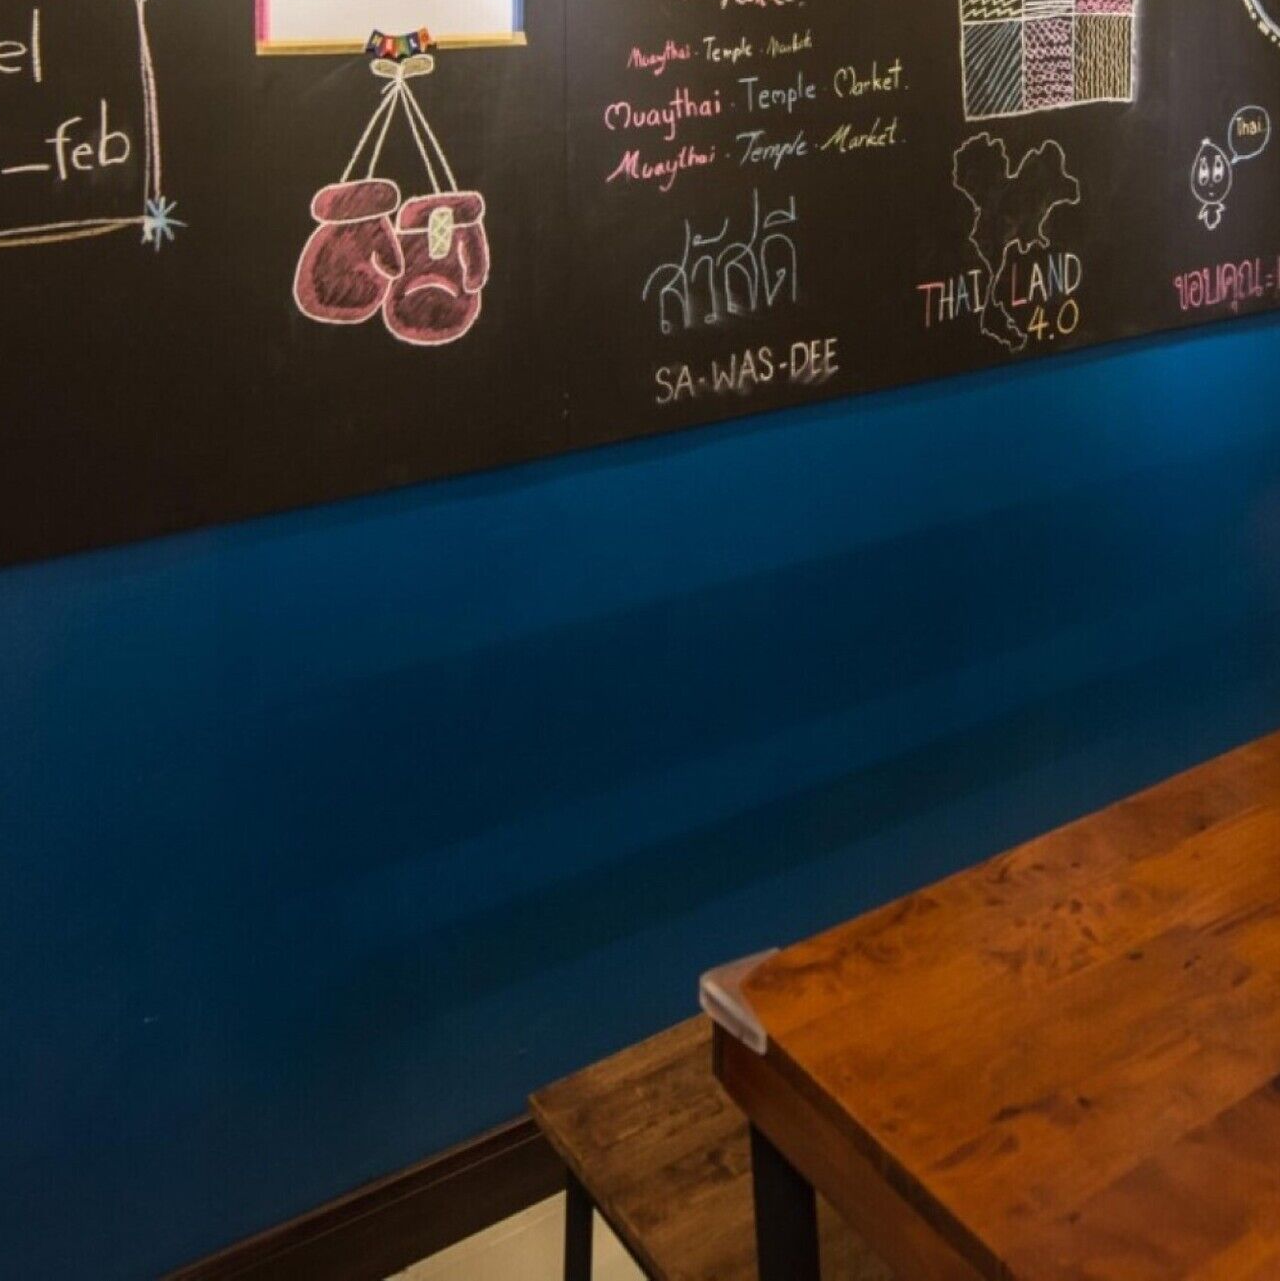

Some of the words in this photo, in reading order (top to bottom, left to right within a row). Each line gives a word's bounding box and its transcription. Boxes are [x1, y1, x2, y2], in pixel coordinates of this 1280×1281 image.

[604, 86, 721, 141] Muaythai
[737, 72, 816, 113] Temple
[606, 145, 716, 192] Muaythai
[735, 130, 809, 170] Temple
[1028, 299, 1080, 341] 4.0
